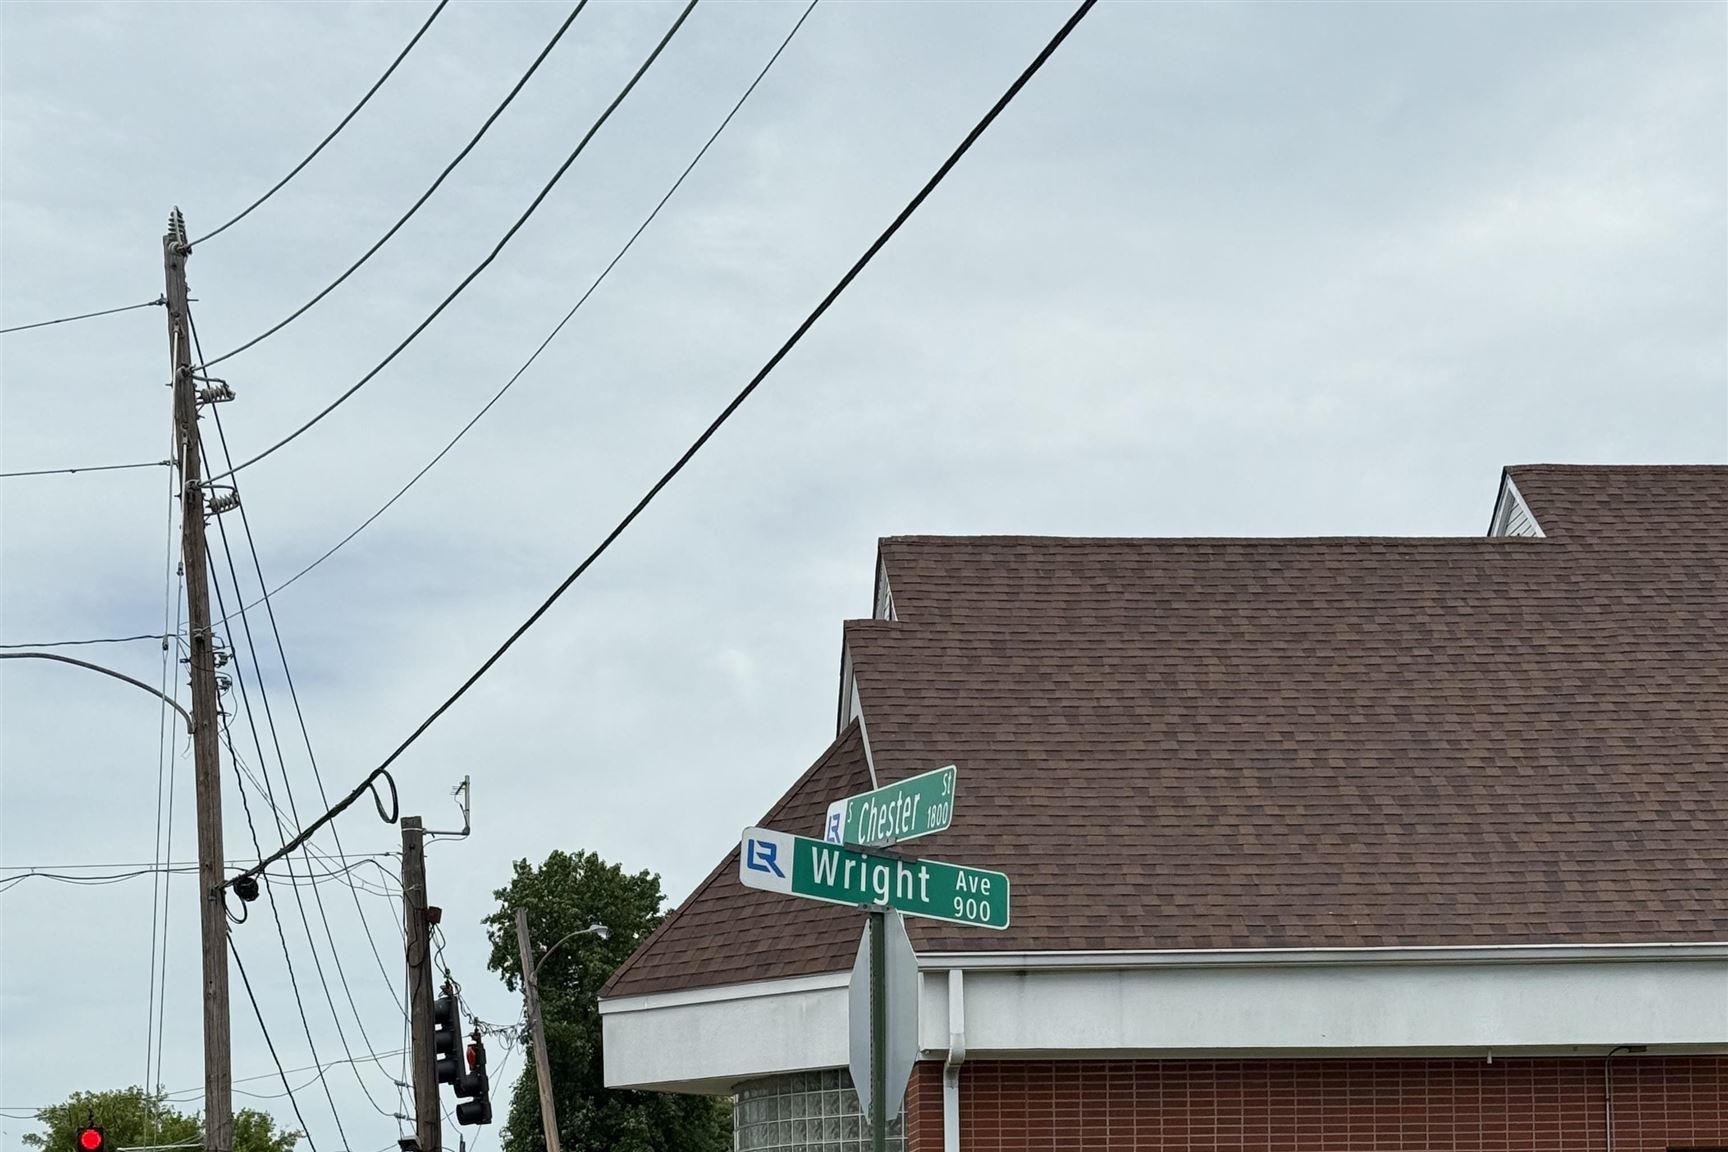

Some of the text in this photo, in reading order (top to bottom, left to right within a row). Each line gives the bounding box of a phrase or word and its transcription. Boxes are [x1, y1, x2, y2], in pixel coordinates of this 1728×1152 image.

[847, 771, 952, 844] S Chester St
[927, 802, 949, 828] 1800
[747, 838, 786, 879] LR
[811, 846, 991, 905] Wright Ave
[953, 896, 991, 922] 900
